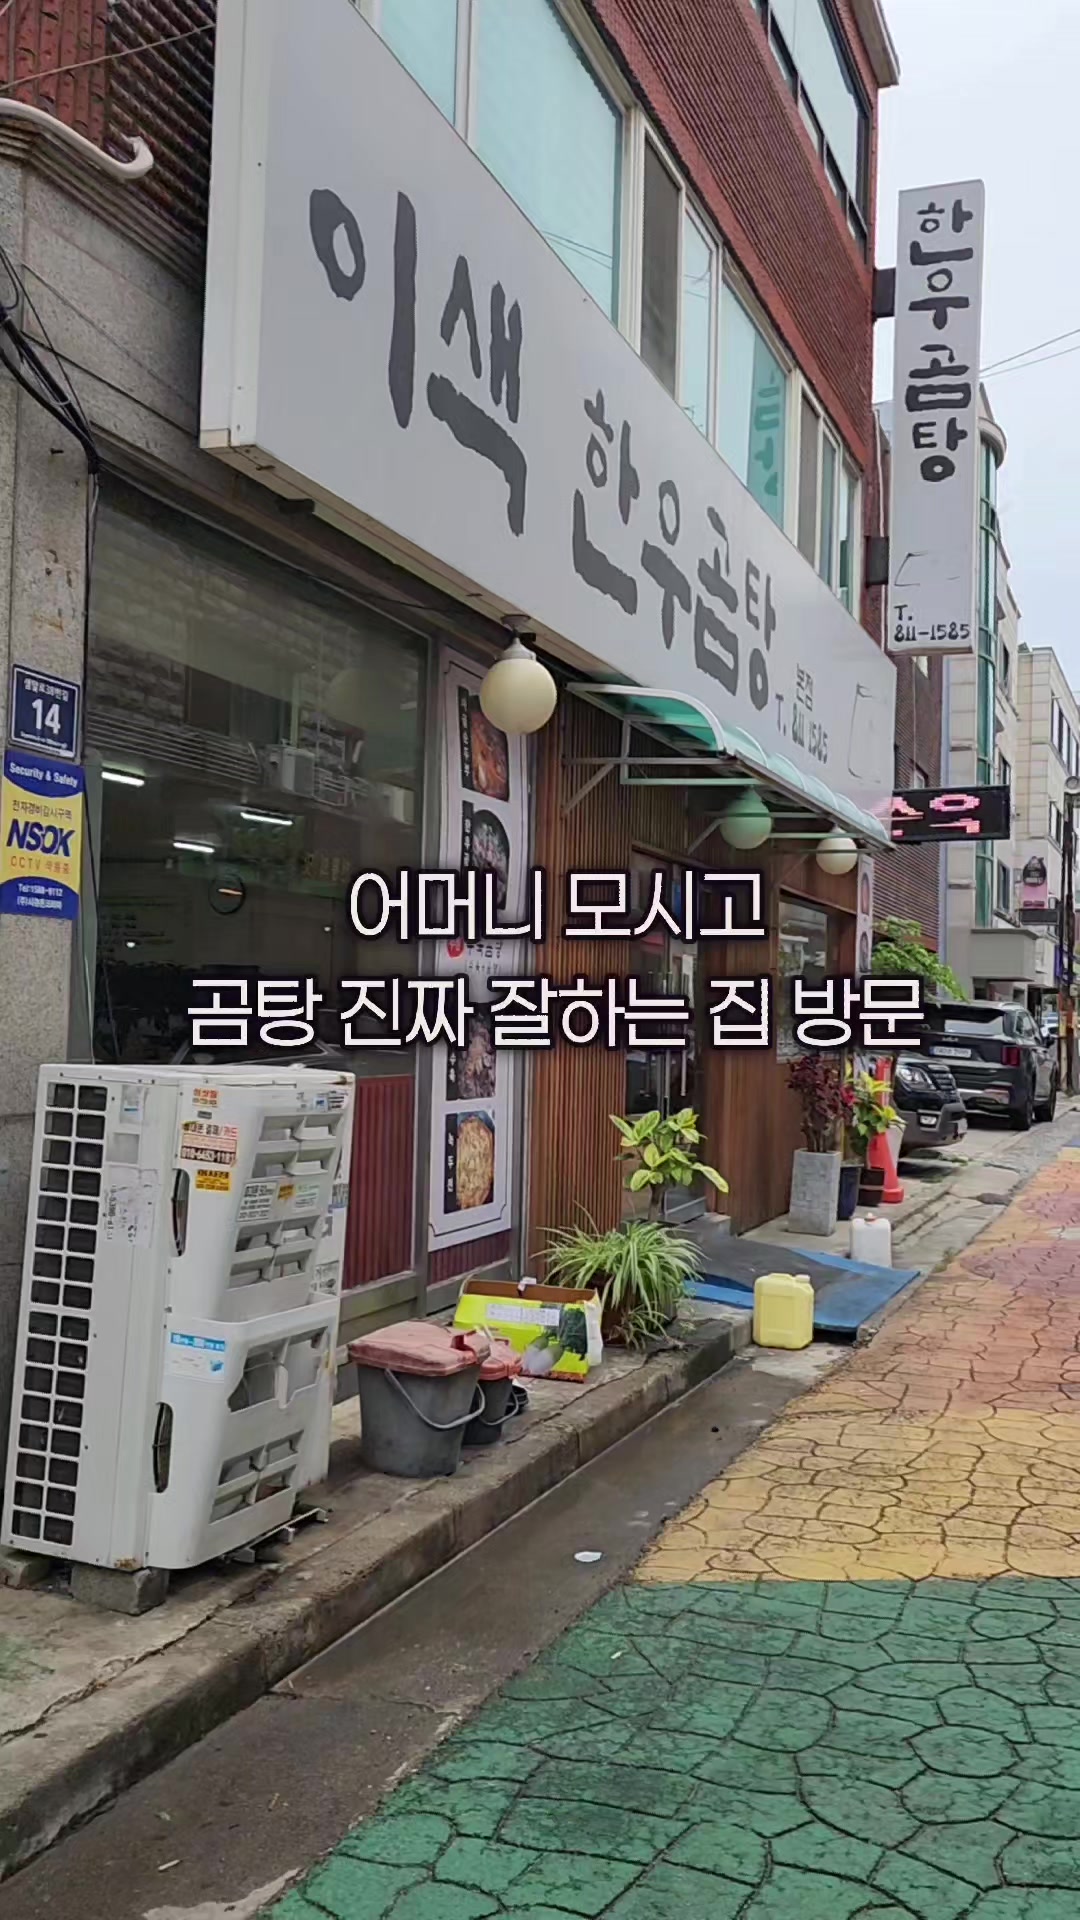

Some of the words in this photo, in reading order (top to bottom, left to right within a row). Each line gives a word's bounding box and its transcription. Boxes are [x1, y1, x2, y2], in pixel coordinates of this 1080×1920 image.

[905, 198, 973, 483] 한우곰탕
[309, 188, 527, 536] 이색
[894, 604, 913, 621] T.
[893, 622, 971, 643] 811-1585
[796, 663, 813, 711] 본점
[31, 698, 61, 735] 14
[9, 762, 44, 782] Security
[45, 770, 52, 781] &
[53, 771, 78, 788] Safety
[6, 818, 76, 858] NSOK
[10, 856, 41, 871] CCTV
